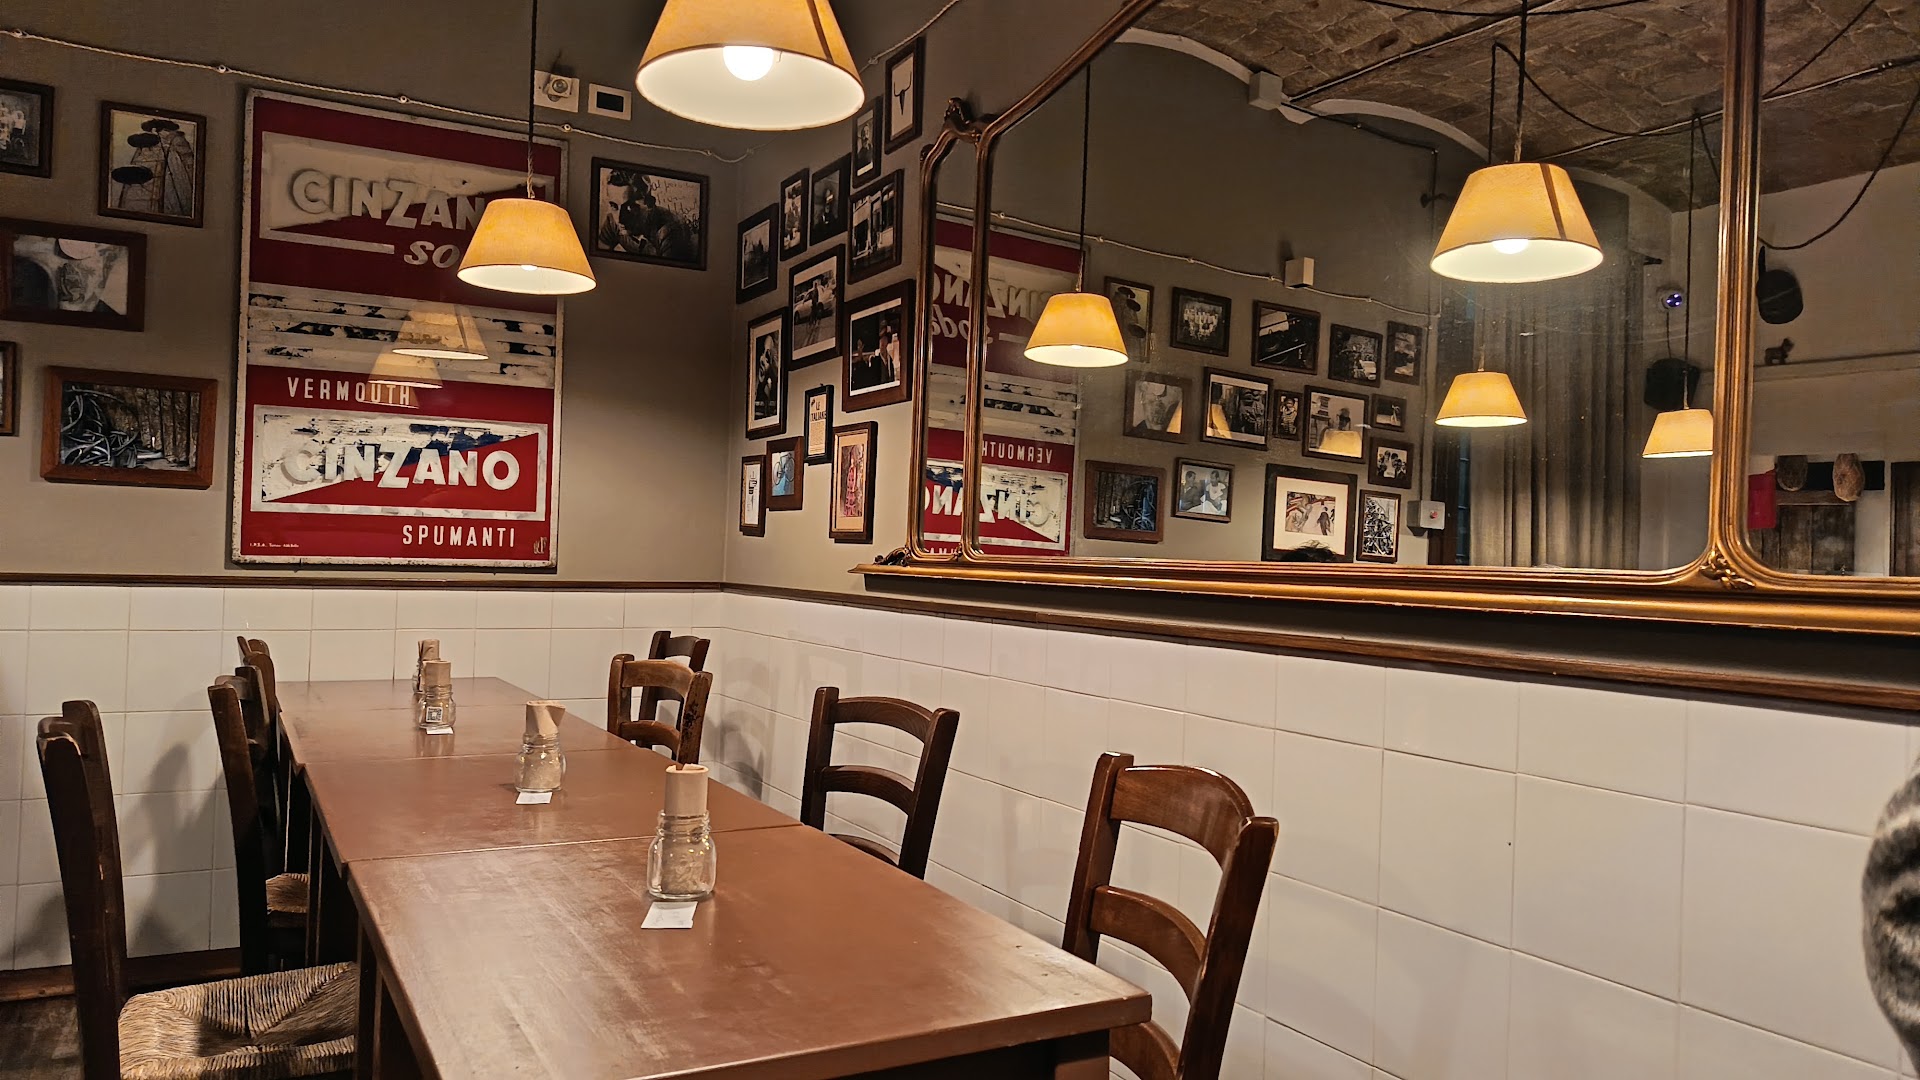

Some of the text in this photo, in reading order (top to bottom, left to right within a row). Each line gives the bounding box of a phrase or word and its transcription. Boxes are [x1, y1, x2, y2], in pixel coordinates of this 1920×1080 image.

[292, 169, 486, 231] CINZAN
[287, 376, 411, 405] VERMOUTH
[281, 444, 520, 491] CINZANO
[402, 524, 516, 548] SPUMANTI
